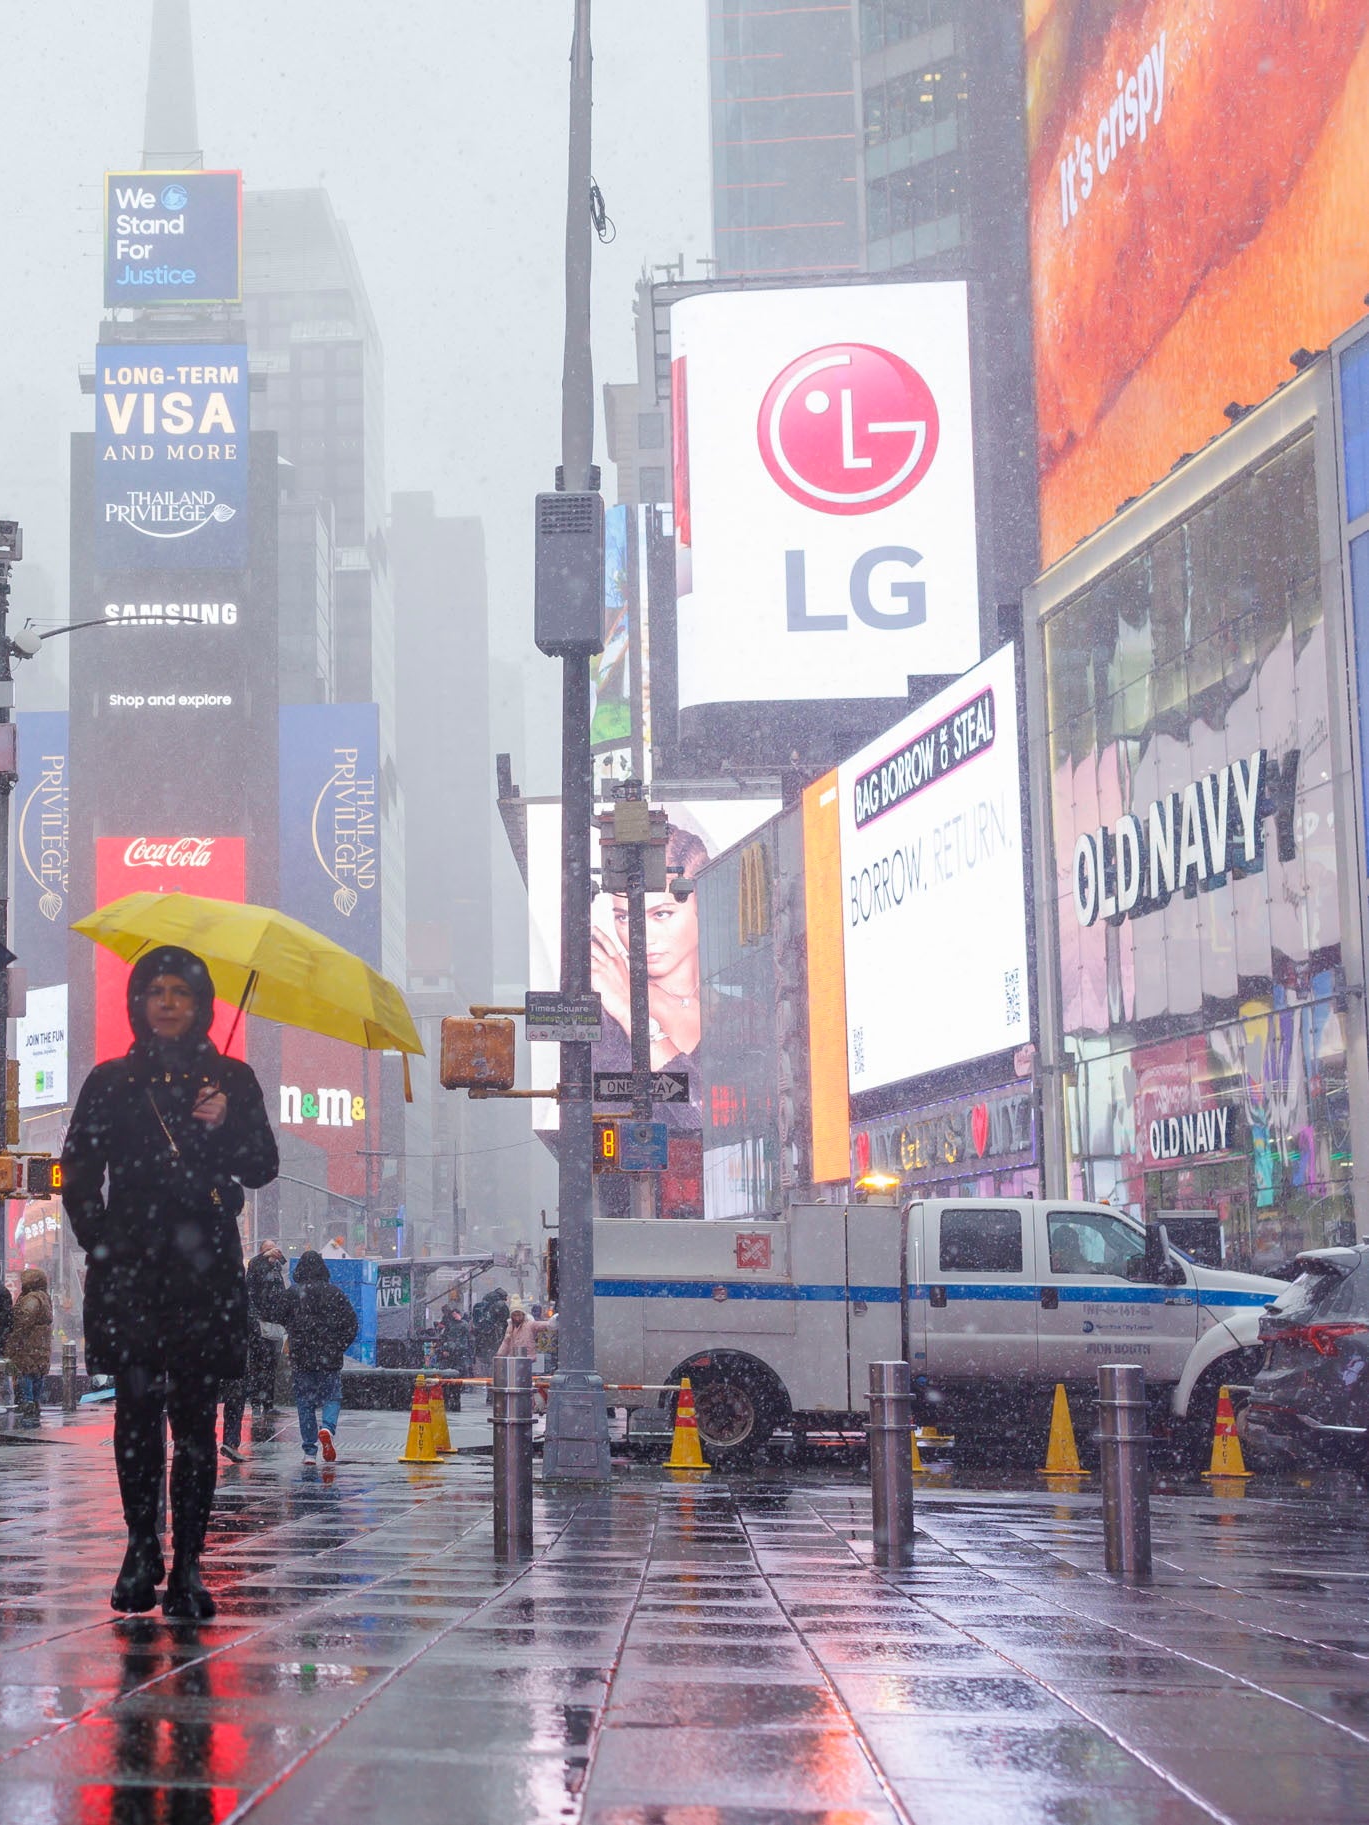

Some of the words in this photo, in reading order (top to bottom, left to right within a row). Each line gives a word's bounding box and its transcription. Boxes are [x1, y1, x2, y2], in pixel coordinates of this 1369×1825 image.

[1059, 135, 1093, 227] It's
[1096, 31, 1167, 176] crispy
[116, 188, 156, 209] We
[116, 215, 184, 235] Stand
[116, 240, 153, 260] For
[116, 265, 196, 285] Justice
[105, 367, 239, 385] LONG-TERM
[103, 392, 236, 434] VISA
[103, 445, 154, 460] AND
[167, 444, 237, 460] MORE
[127, 491, 215, 506] THAILAND
[105, 504, 206, 523] PRIVILEGE
[785, 544, 927, 632] LG
[104, 603, 238, 626] SAMSUNG
[109, 693, 144, 708] Shop
[148, 694, 175, 706] and
[179, 693, 231, 708] explore
[855, 773, 880, 823] BAG
[881, 734, 935, 808] BORROW
[954, 697, 994, 760] STEAL
[41, 755, 65, 884] PRIVILEGE
[334, 748, 358, 878] PRIVILEGE
[356, 774, 376, 889] THAILAND
[1072, 814, 1142, 928] OLD
[1148, 748, 1268, 900] NAVY
[124, 837, 215, 868] Coca-Cola
[529, 1003, 555, 1013] Times
[557, 1003, 589, 1014] Square
[26, 1034, 40, 1047] JOIN
[40, 1031, 52, 1045] THE
[53, 1029, 64, 1042] FUN
[607, 1081, 632, 1093] ONE
[603, 1130, 614, 1157] 8
[1149, 1117, 1180, 1160] OLD
[1182, 1106, 1228, 1155] NAVY
